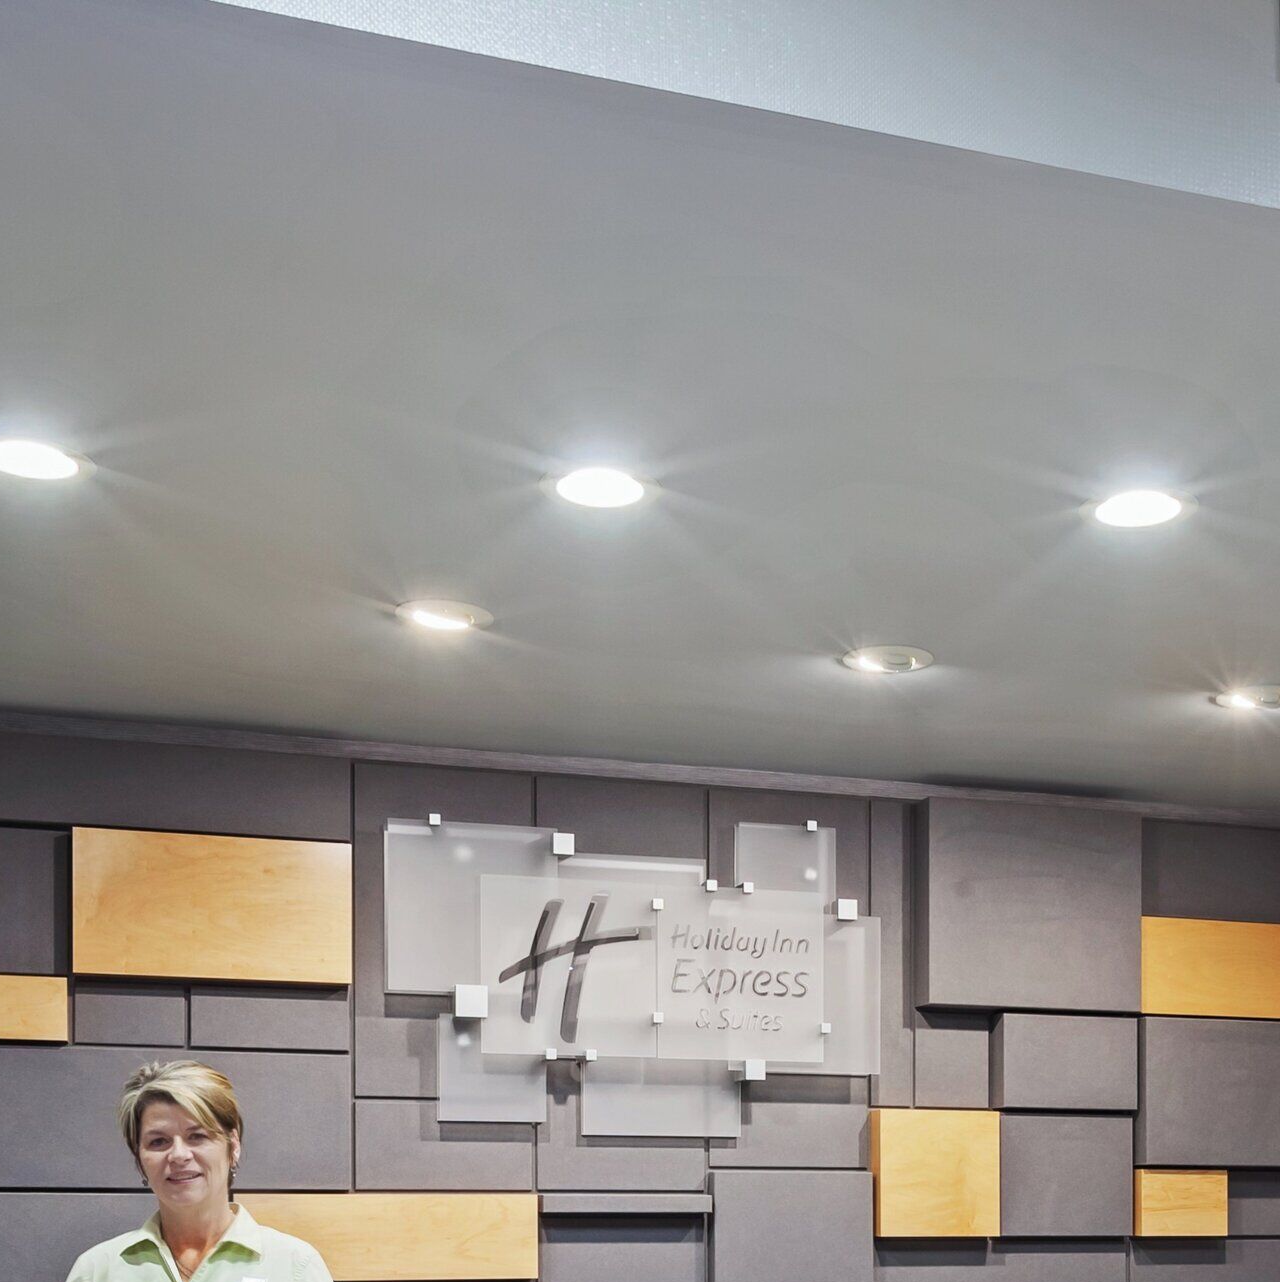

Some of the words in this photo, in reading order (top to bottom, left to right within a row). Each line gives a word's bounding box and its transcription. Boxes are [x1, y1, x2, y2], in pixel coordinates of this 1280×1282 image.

[671, 924, 765, 959] Holiday
[773, 928, 810, 955] Inn
[670, 958, 810, 1005] Express
[695, 1008, 712, 1029] &
[718, 1009, 784, 1033] Suites
